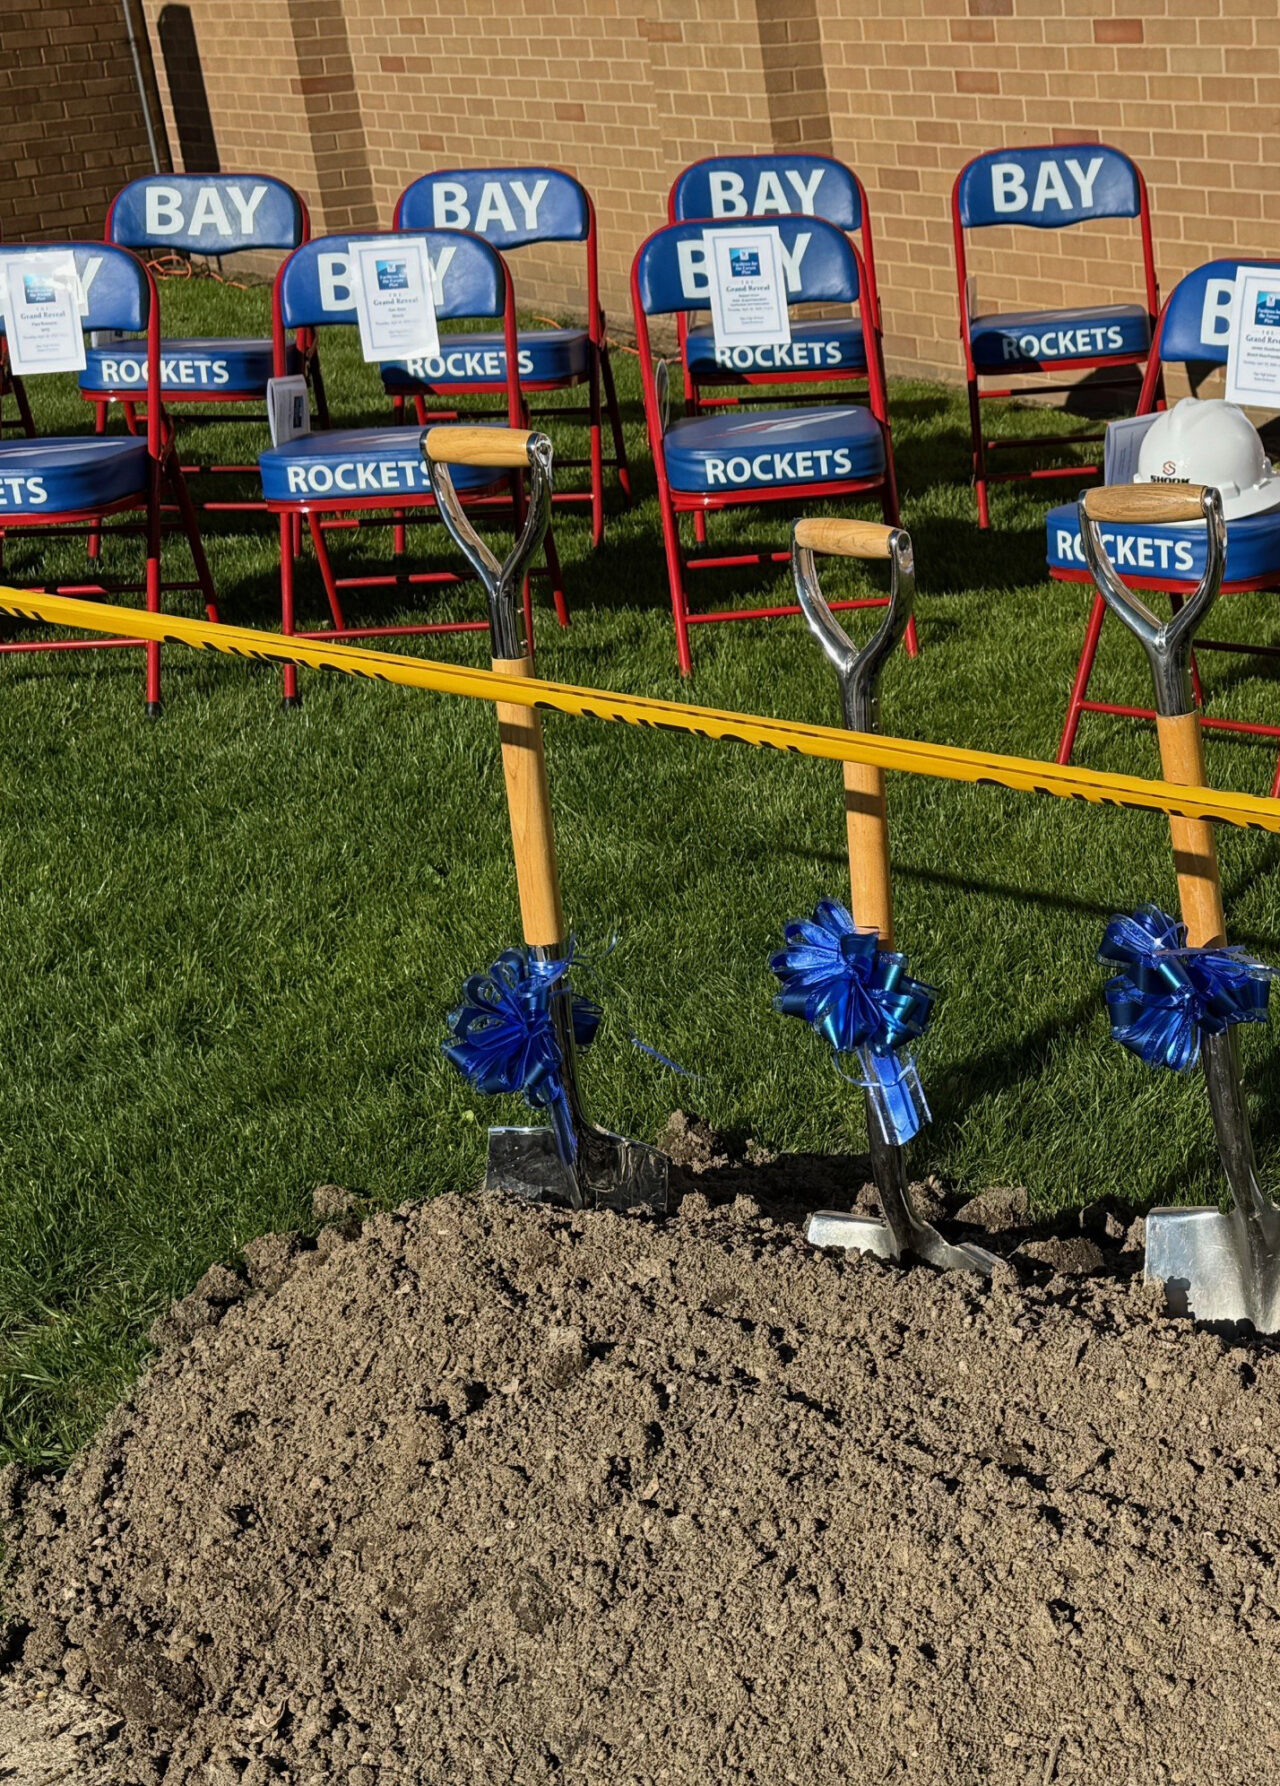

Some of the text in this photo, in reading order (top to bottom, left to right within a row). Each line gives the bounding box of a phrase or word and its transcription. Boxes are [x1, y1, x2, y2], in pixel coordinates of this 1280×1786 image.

[145, 185, 269, 236] BAY
[432, 179, 550, 232] BAY
[709, 169, 825, 218] BAY
[991, 157, 1104, 213] BAY
[318, 246, 458, 312] BY
[677, 233, 812, 299] BY
[715, 341, 842, 368] ROCKETS
[1002, 326, 1123, 360] ROCKETS
[705, 448, 852, 485] ROCKETS
